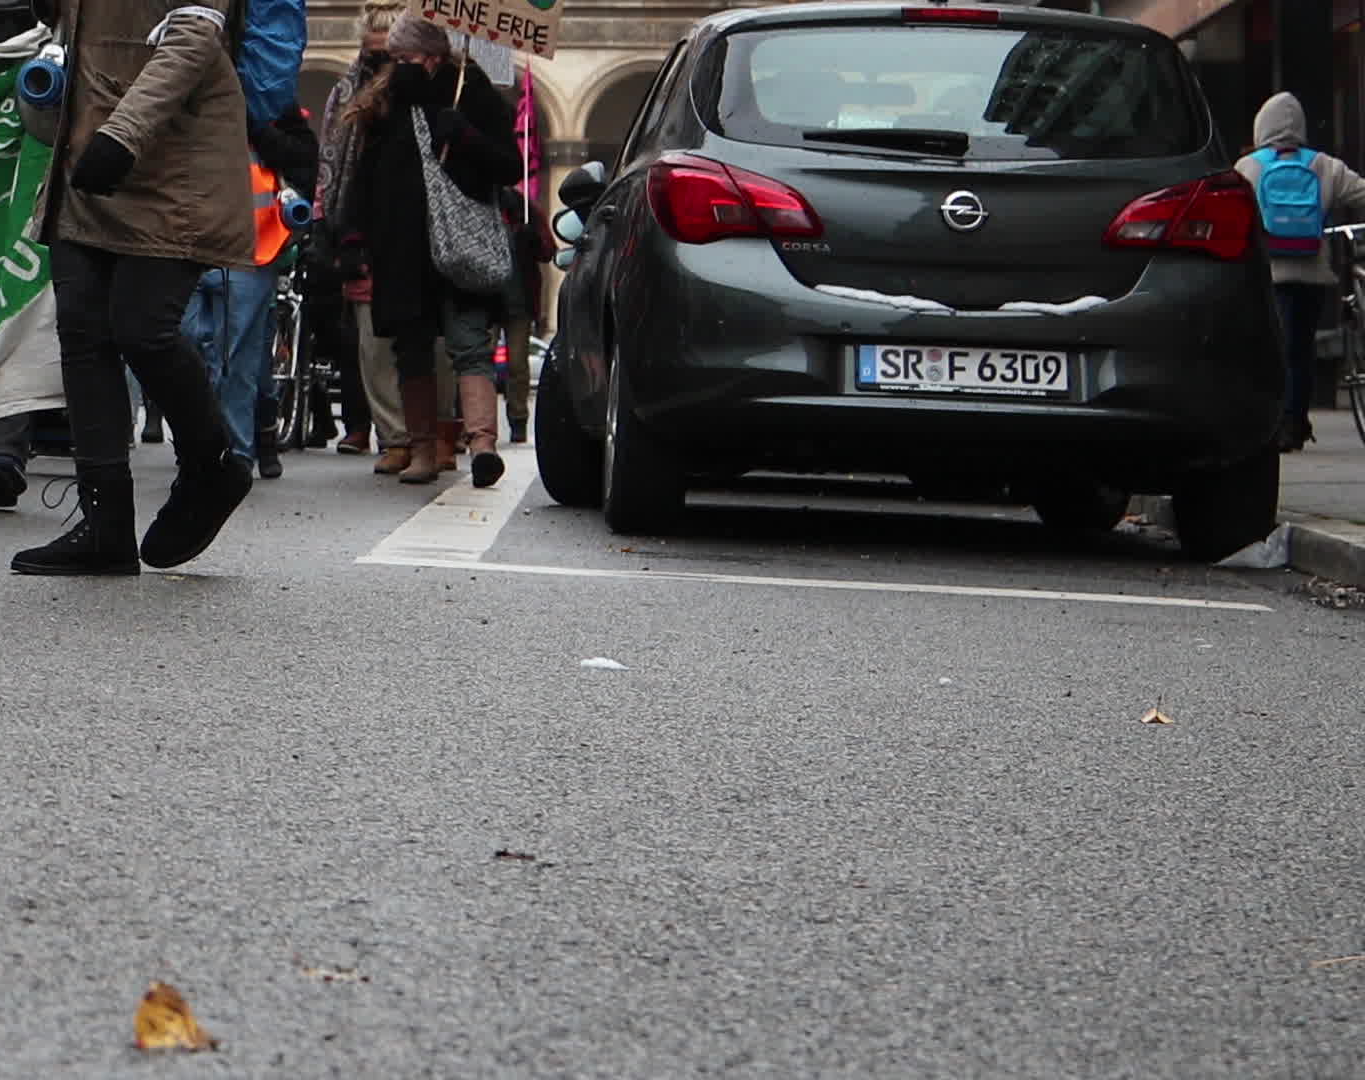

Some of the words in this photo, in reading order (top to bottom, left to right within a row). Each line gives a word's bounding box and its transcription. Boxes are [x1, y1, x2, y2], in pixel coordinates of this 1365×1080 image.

[496, 12, 549, 46] ERDE
[782, 241, 831, 253] CORSA
[880, 349, 924, 380] SR
[948, 351, 969, 382] F
[977, 352, 1062, 385] 6309
